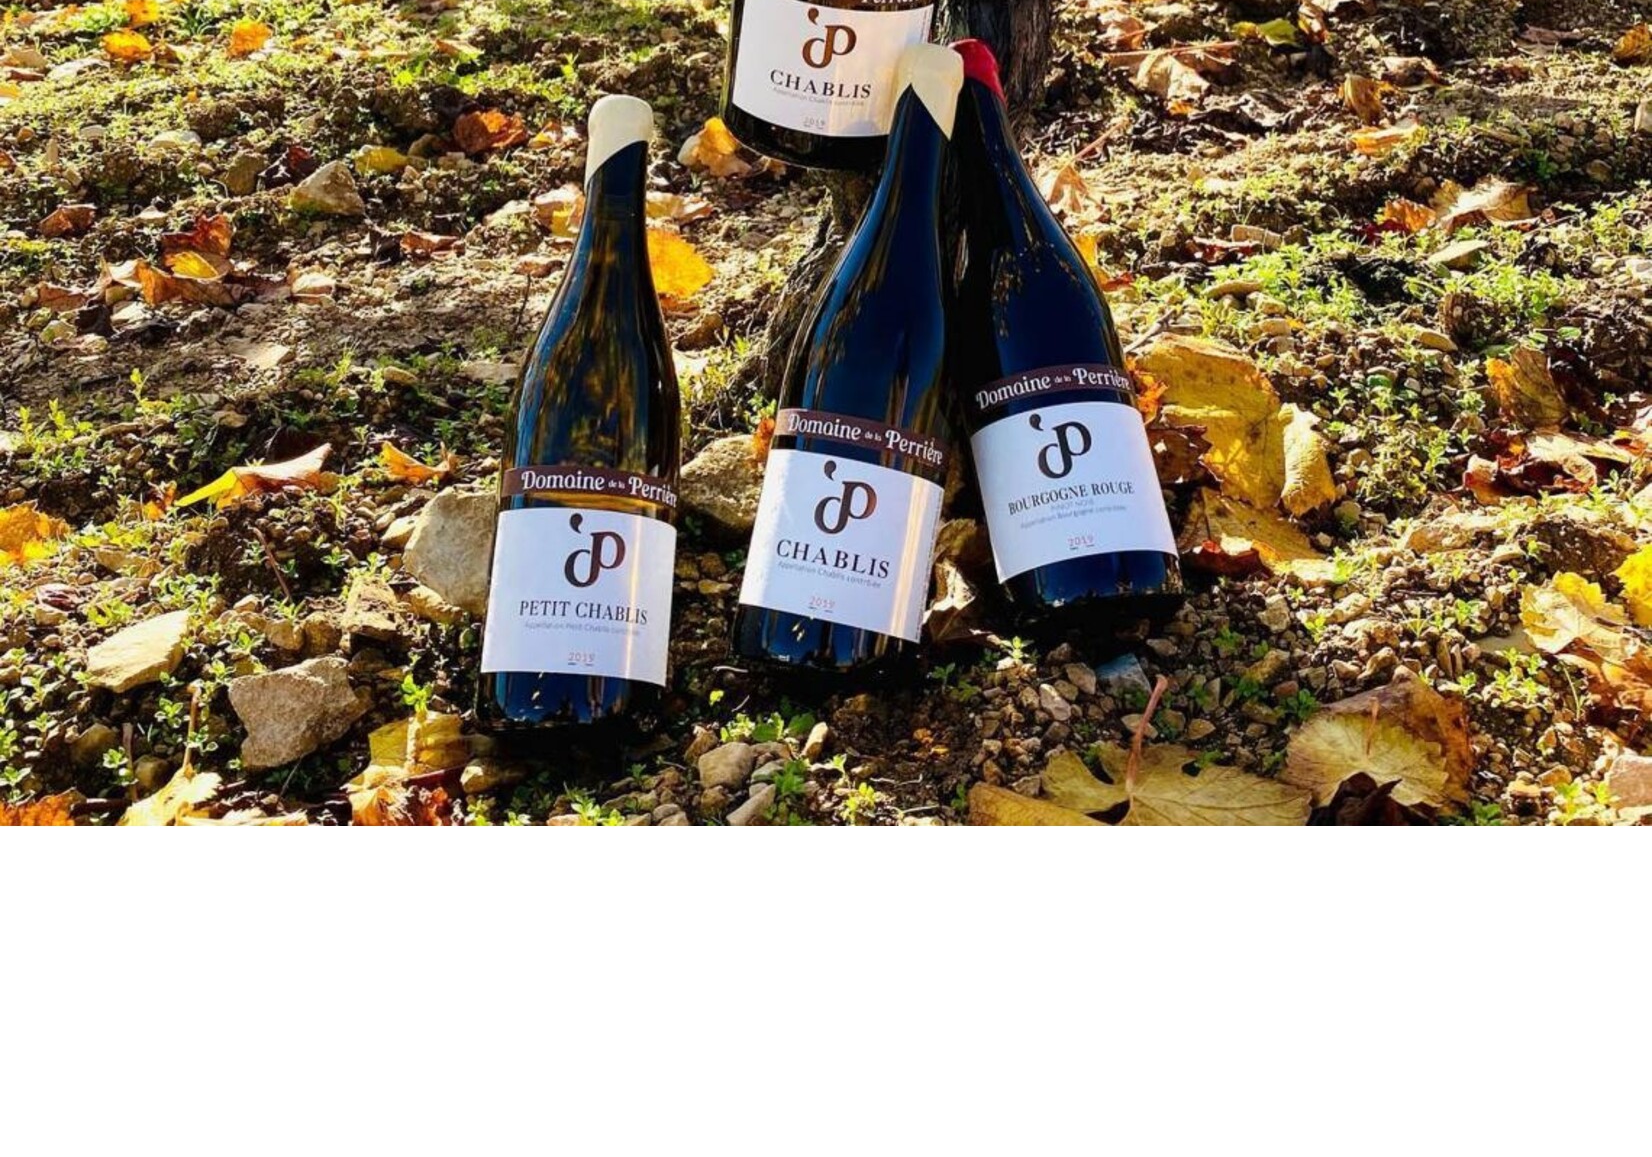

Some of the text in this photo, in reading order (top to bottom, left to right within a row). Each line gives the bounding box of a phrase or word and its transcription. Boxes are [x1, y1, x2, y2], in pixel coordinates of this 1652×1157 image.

[770, 68, 872, 99] CHABLIS
[976, 375, 1051, 410] Domaine
[1072, 367, 1131, 392] Perrière
[788, 413, 861, 441] Domaine
[865, 431, 873, 440] de
[885, 429, 943, 465] Perrière
[521, 470, 605, 491] Domaine
[608, 479, 617, 488] de
[1008, 484, 1089, 516] BOURGOGNE
[1091, 481, 1135, 497] ROUGE
[1067, 535, 1095, 546] 2019
[776, 539, 890, 579] CHABLIS
[519, 600, 648, 625] PETIT CHABLIS
